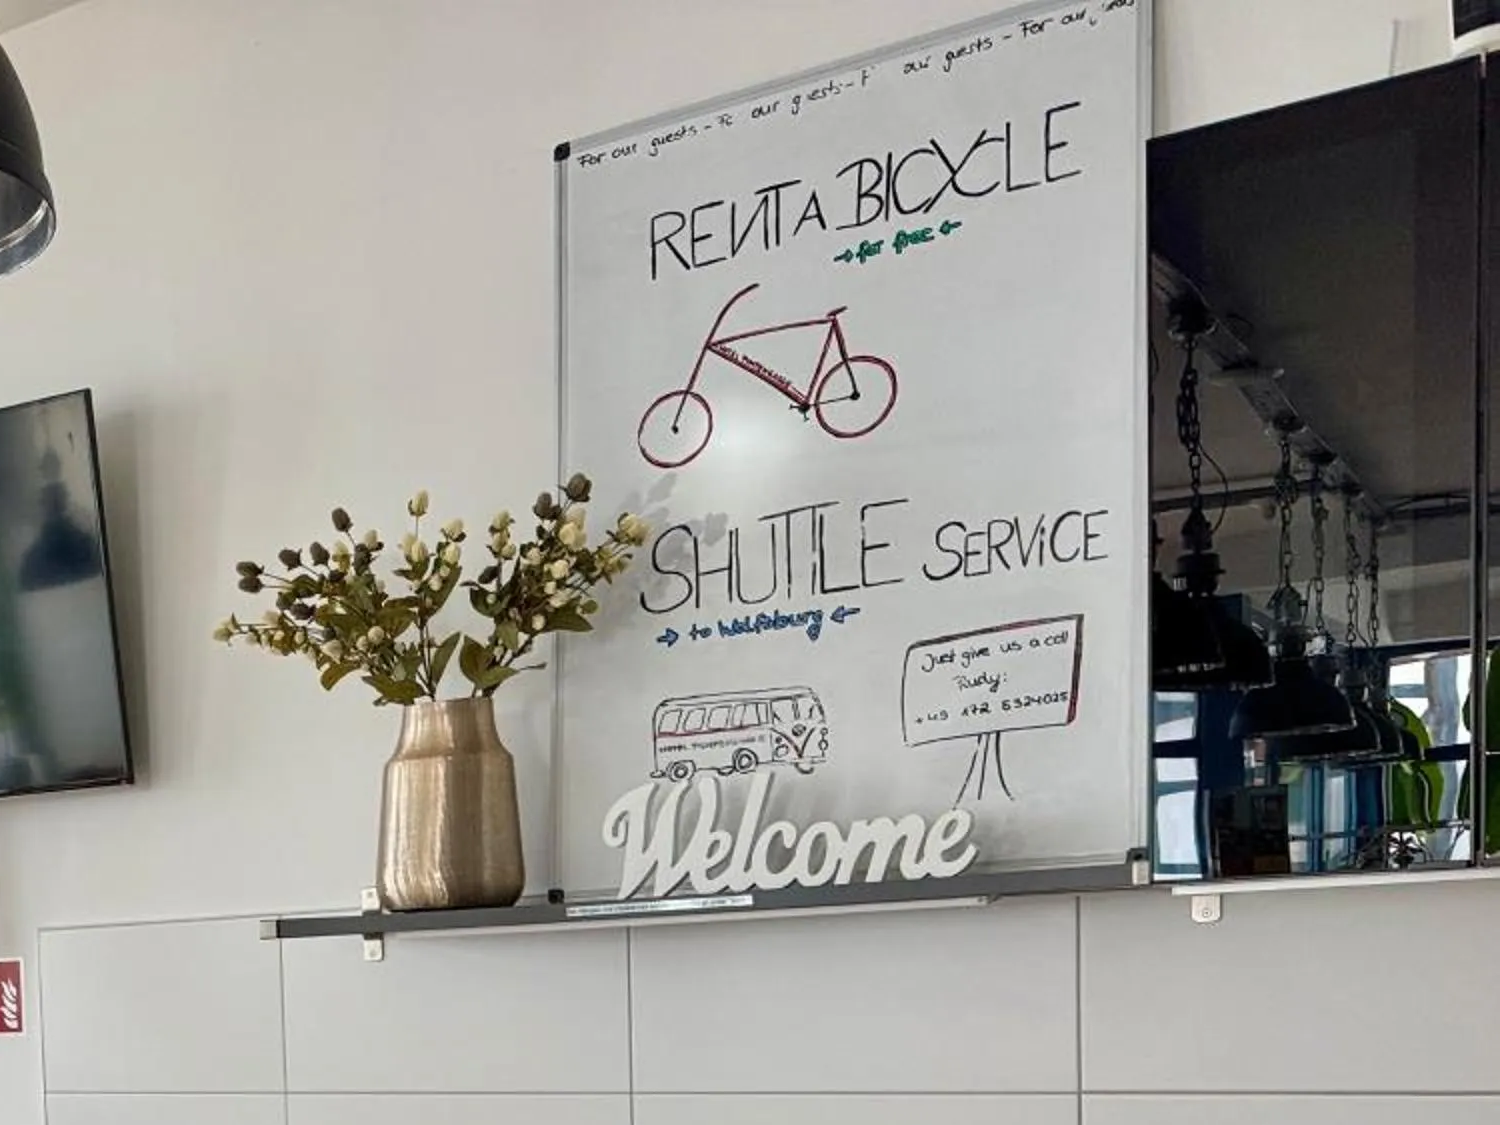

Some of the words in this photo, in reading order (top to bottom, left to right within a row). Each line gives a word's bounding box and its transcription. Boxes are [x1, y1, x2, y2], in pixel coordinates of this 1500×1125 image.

[576, 152, 605, 167] For
[611, 143, 638, 159] our
[649, 125, 699, 157] guests
[751, 101, 781, 119] our
[942, 36, 994, 73] guests
[649, 180, 802, 280] RENT
[792, 190, 828, 236] A
[835, 101, 1083, 231] BICYCLE
[640, 498, 910, 613] SHUTTLE
[689, 623, 712, 641] to
[921, 648, 957, 673] Just
[961, 646, 991, 669] give
[999, 642, 1023, 653] us
[1029, 637, 1041, 649] a
[602, 772, 978, 901] Welcome
